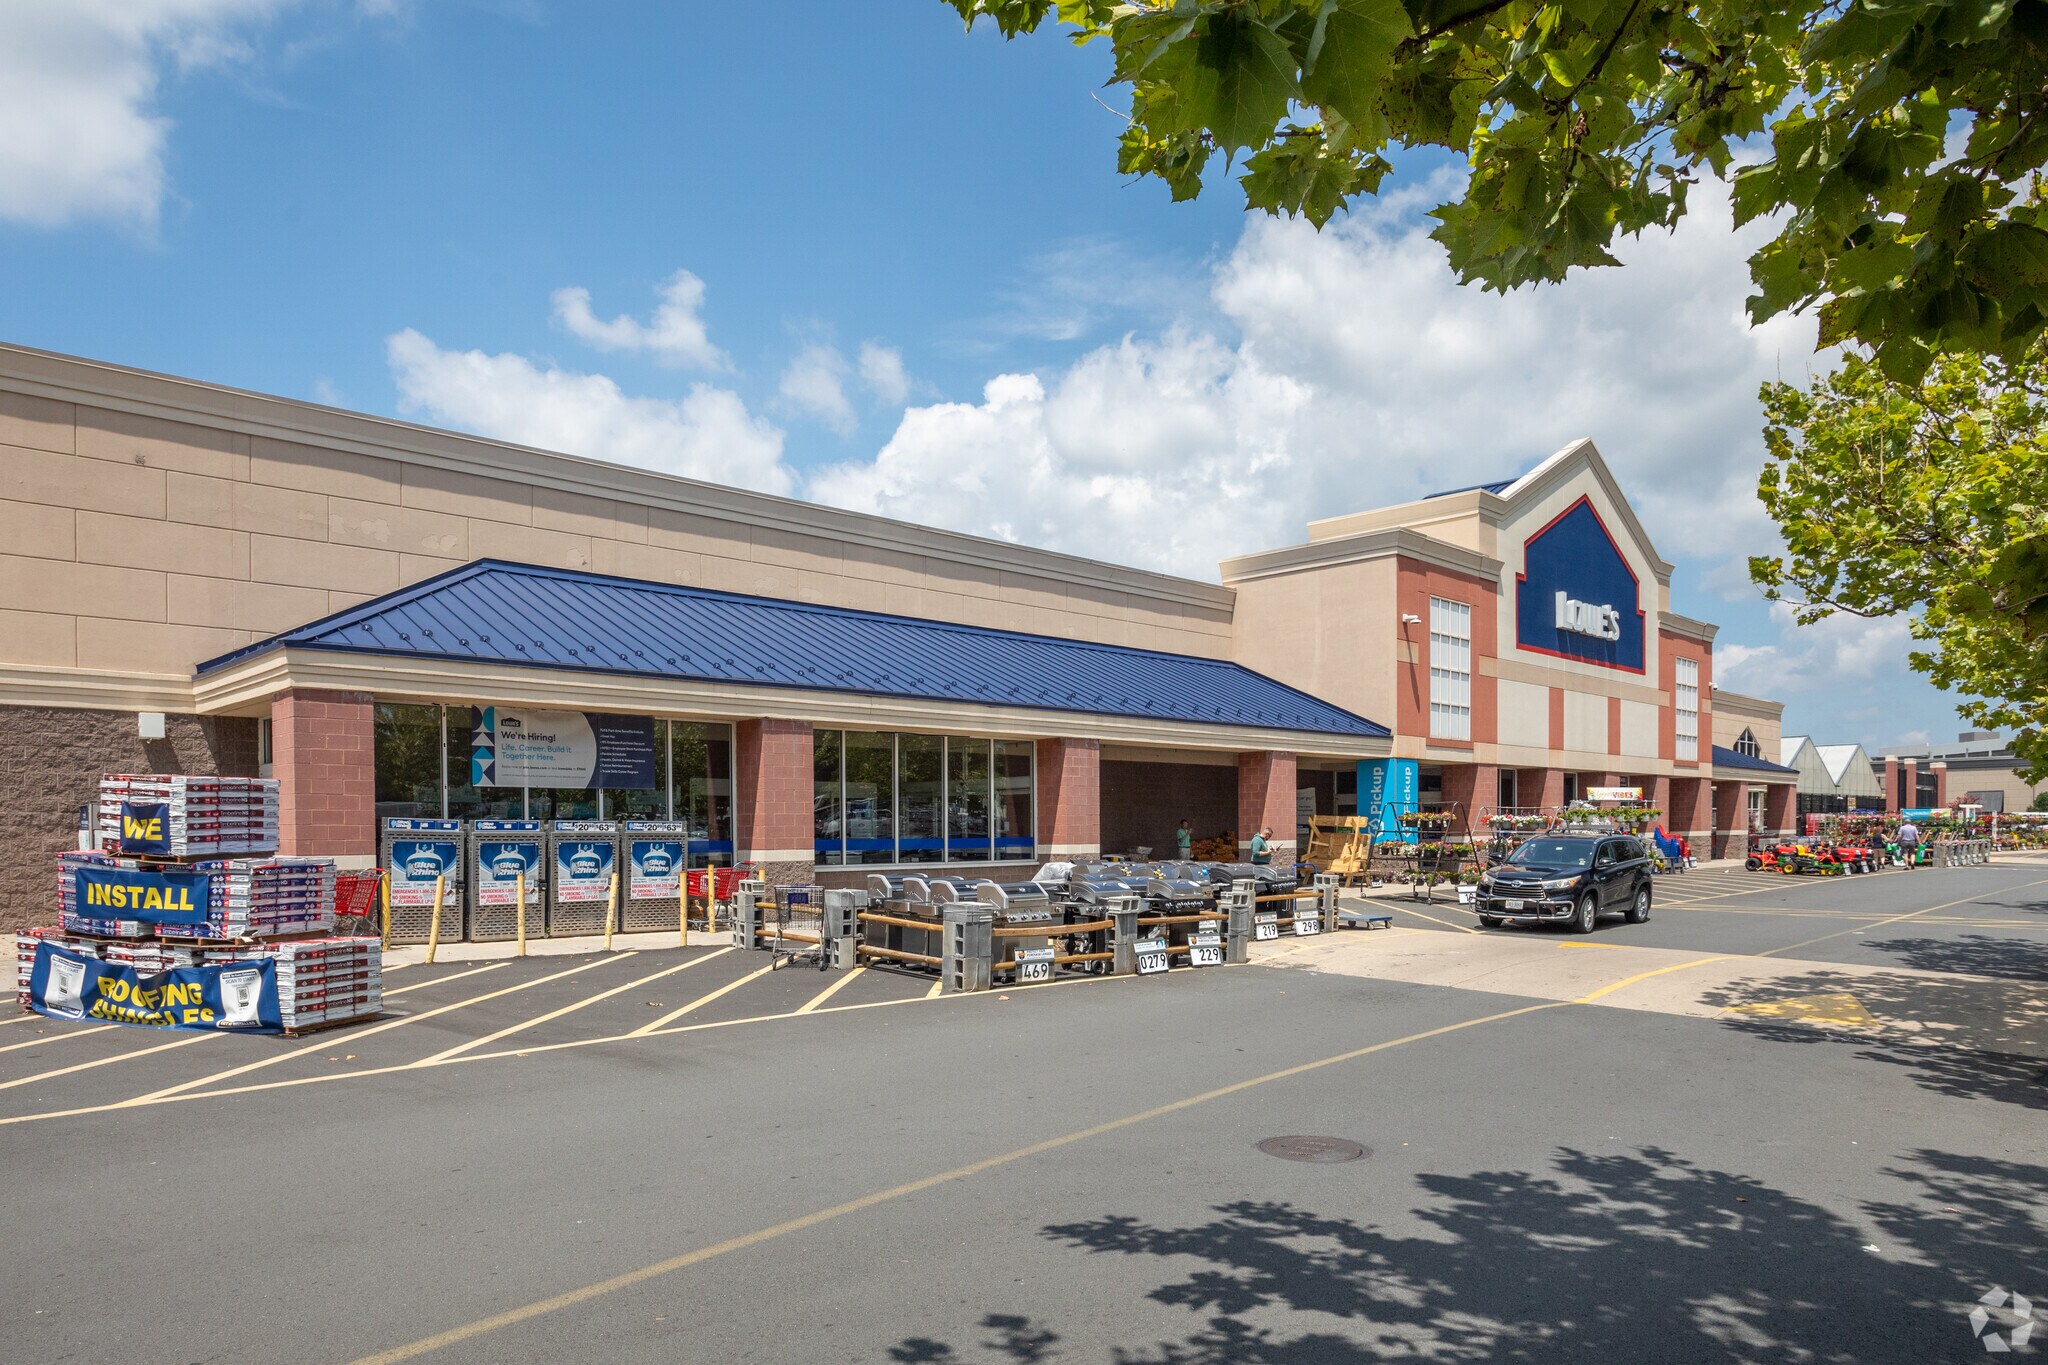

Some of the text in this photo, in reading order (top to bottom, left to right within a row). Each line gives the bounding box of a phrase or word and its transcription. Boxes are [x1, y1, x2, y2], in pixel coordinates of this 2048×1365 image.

[1555, 591, 1620, 641] LOWE'S
[501, 731, 556, 743] We're Hiring!
[501, 751, 556, 761] Together Here.
[518, 744, 546, 752] Career.
[547, 745, 565, 753] Build
[1370, 767, 1384, 815] Pickup
[123, 815, 163, 841] WE
[87, 882, 194, 911] INSTALL
[1262, 924, 1276, 936] 219
[1302, 921, 1318, 932] 298
[1140, 953, 1166, 970] 0279
[1199, 948, 1219, 961] 229
[1024, 963, 1048, 979] 469
[97, 975, 203, 1009] ROOFING
